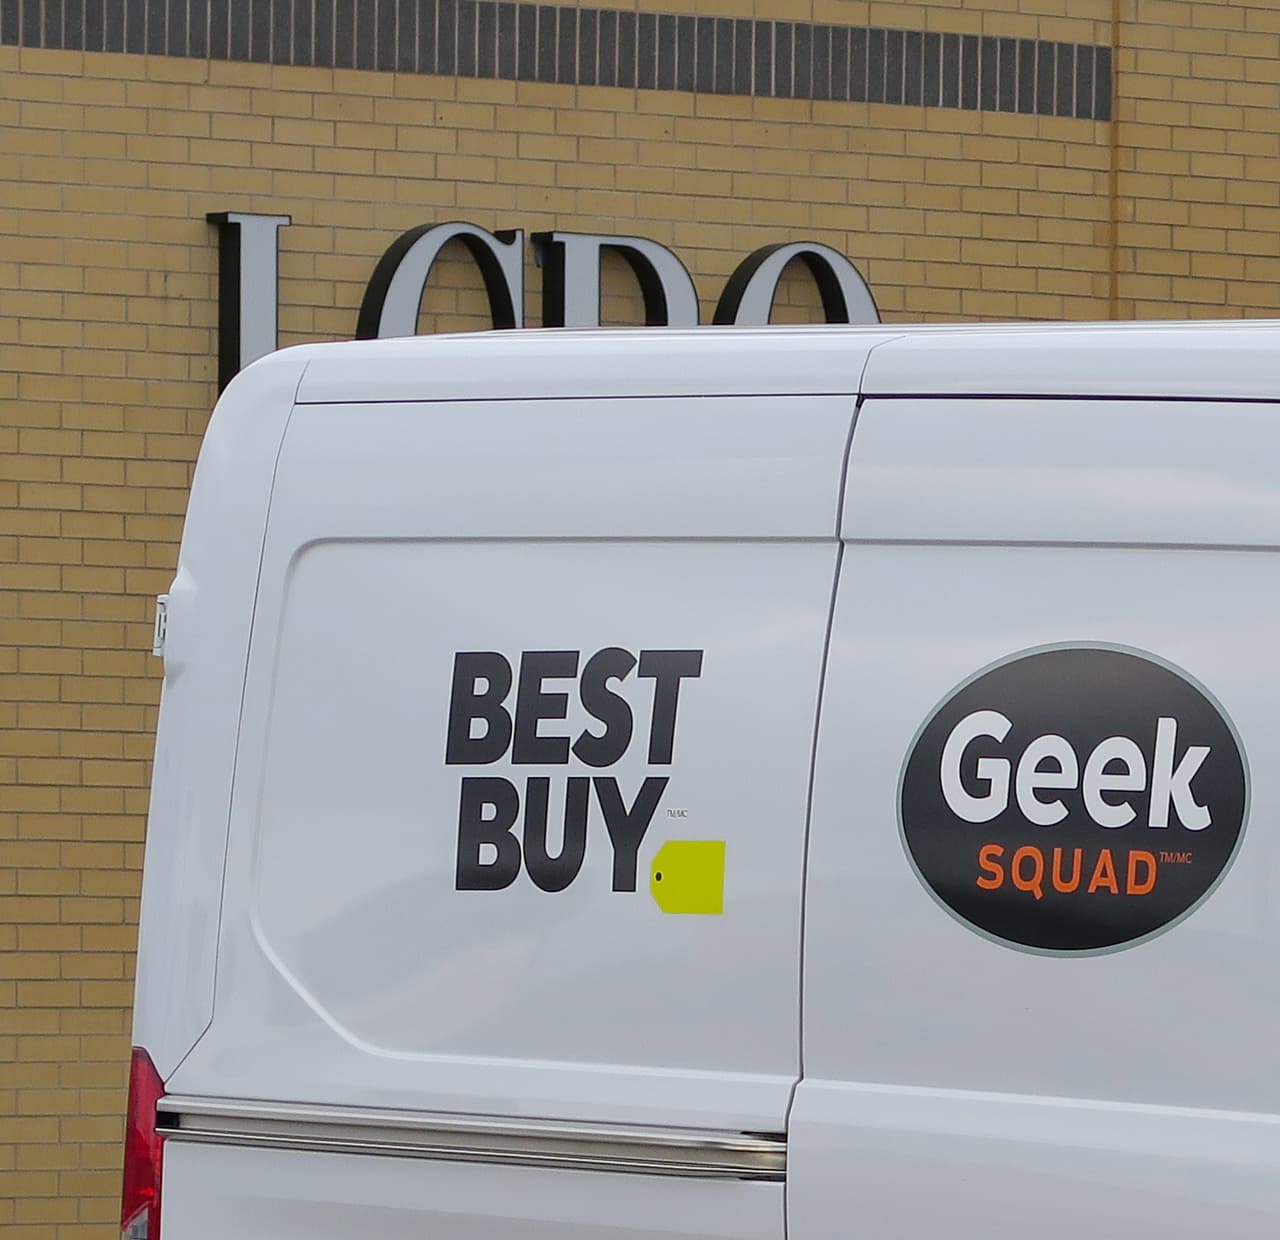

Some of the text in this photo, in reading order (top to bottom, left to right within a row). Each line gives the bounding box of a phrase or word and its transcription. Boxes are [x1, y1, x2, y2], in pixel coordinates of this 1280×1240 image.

[445, 647, 704, 767] BEST
[940, 709, 1213, 831] Geek
[455, 776, 670, 893] BUY
[976, 844, 1158, 900] SQUAD
